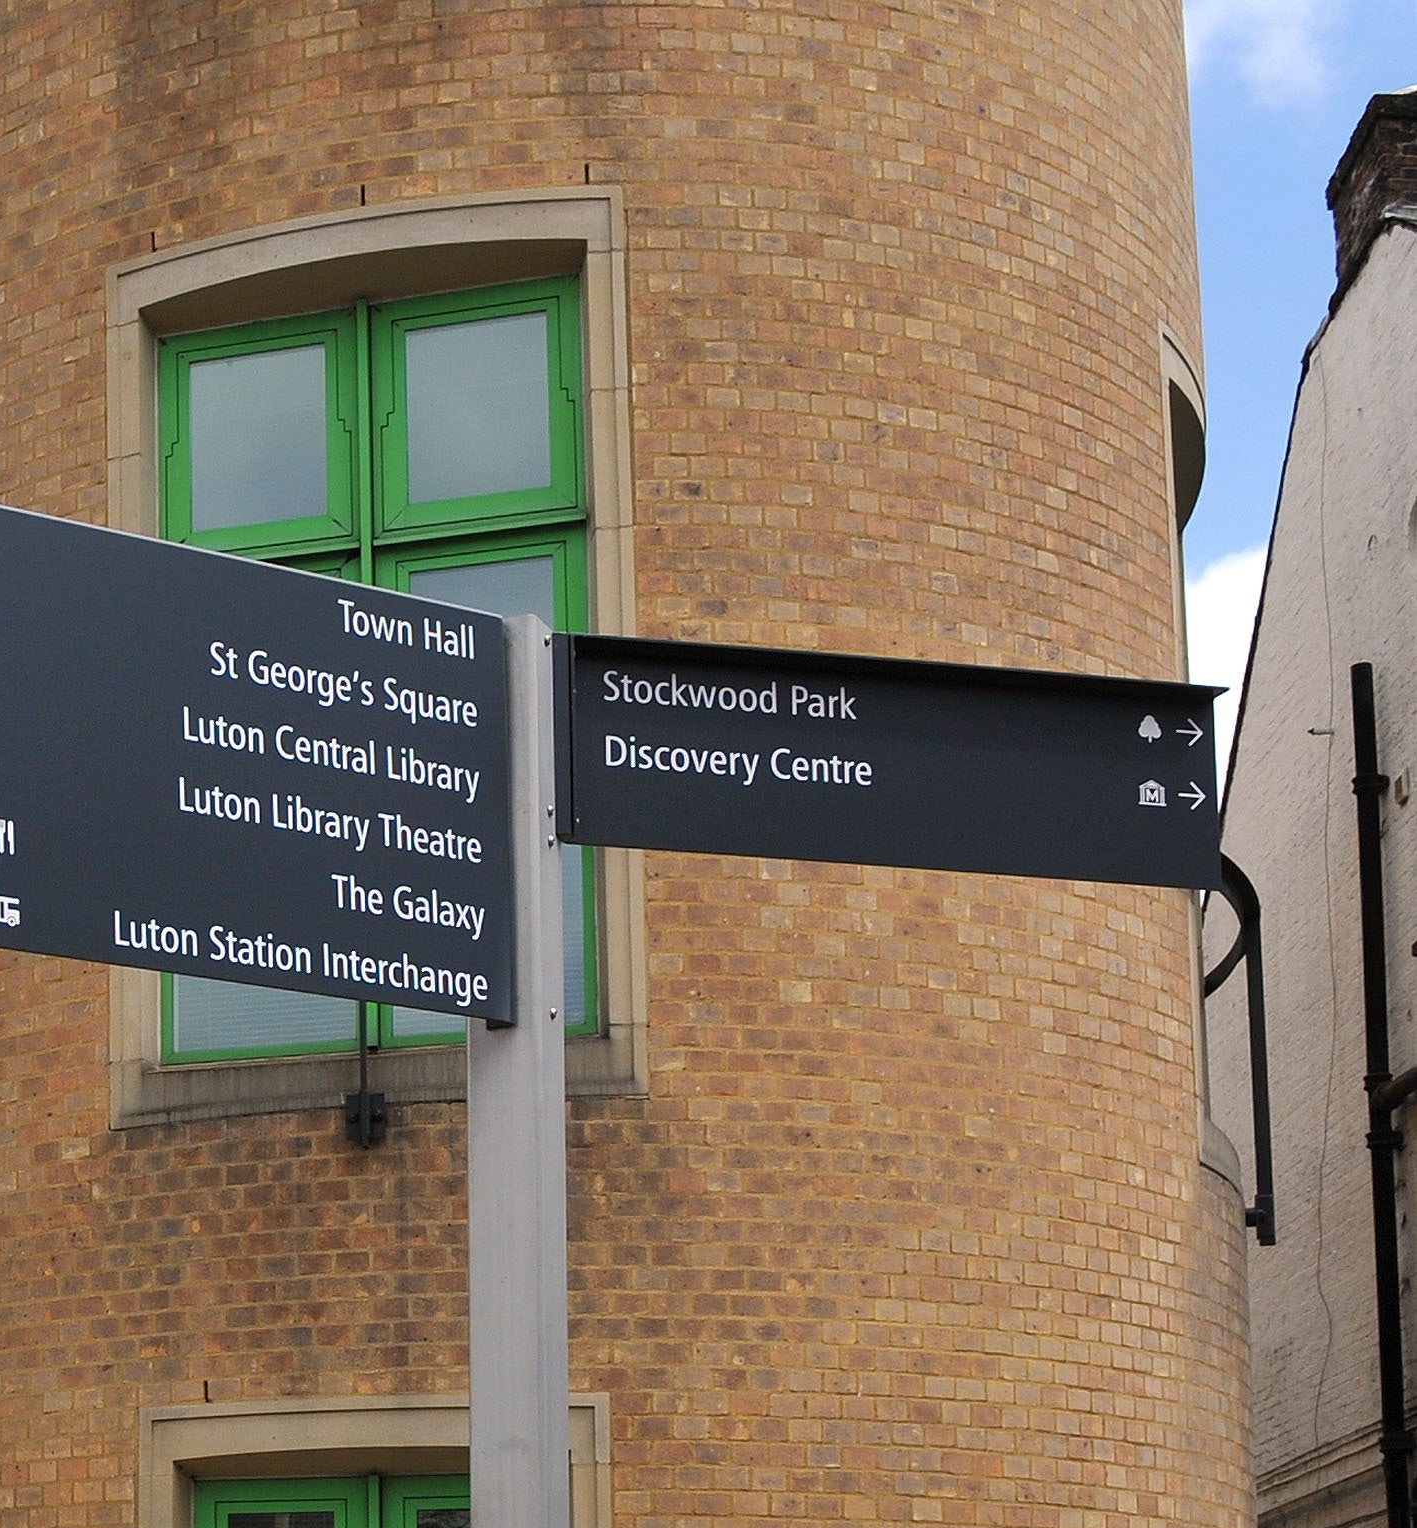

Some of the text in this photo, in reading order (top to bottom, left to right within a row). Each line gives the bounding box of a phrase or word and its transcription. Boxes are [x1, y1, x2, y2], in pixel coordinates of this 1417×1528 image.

[338, 599, 474, 659] Town Hall
[210, 642, 238, 679] St
[384, 678, 477, 727] Square
[604, 671, 856, 719] Stockwood Park
[184, 706, 479, 803] Luton Central Library
[606, 735, 872, 785] Discovery Centre
[179, 777, 481, 863] Luton Library Theatre
[331, 874, 485, 940] The Galaxy
[115, 910, 488, 1006] Luton Station Interchange
